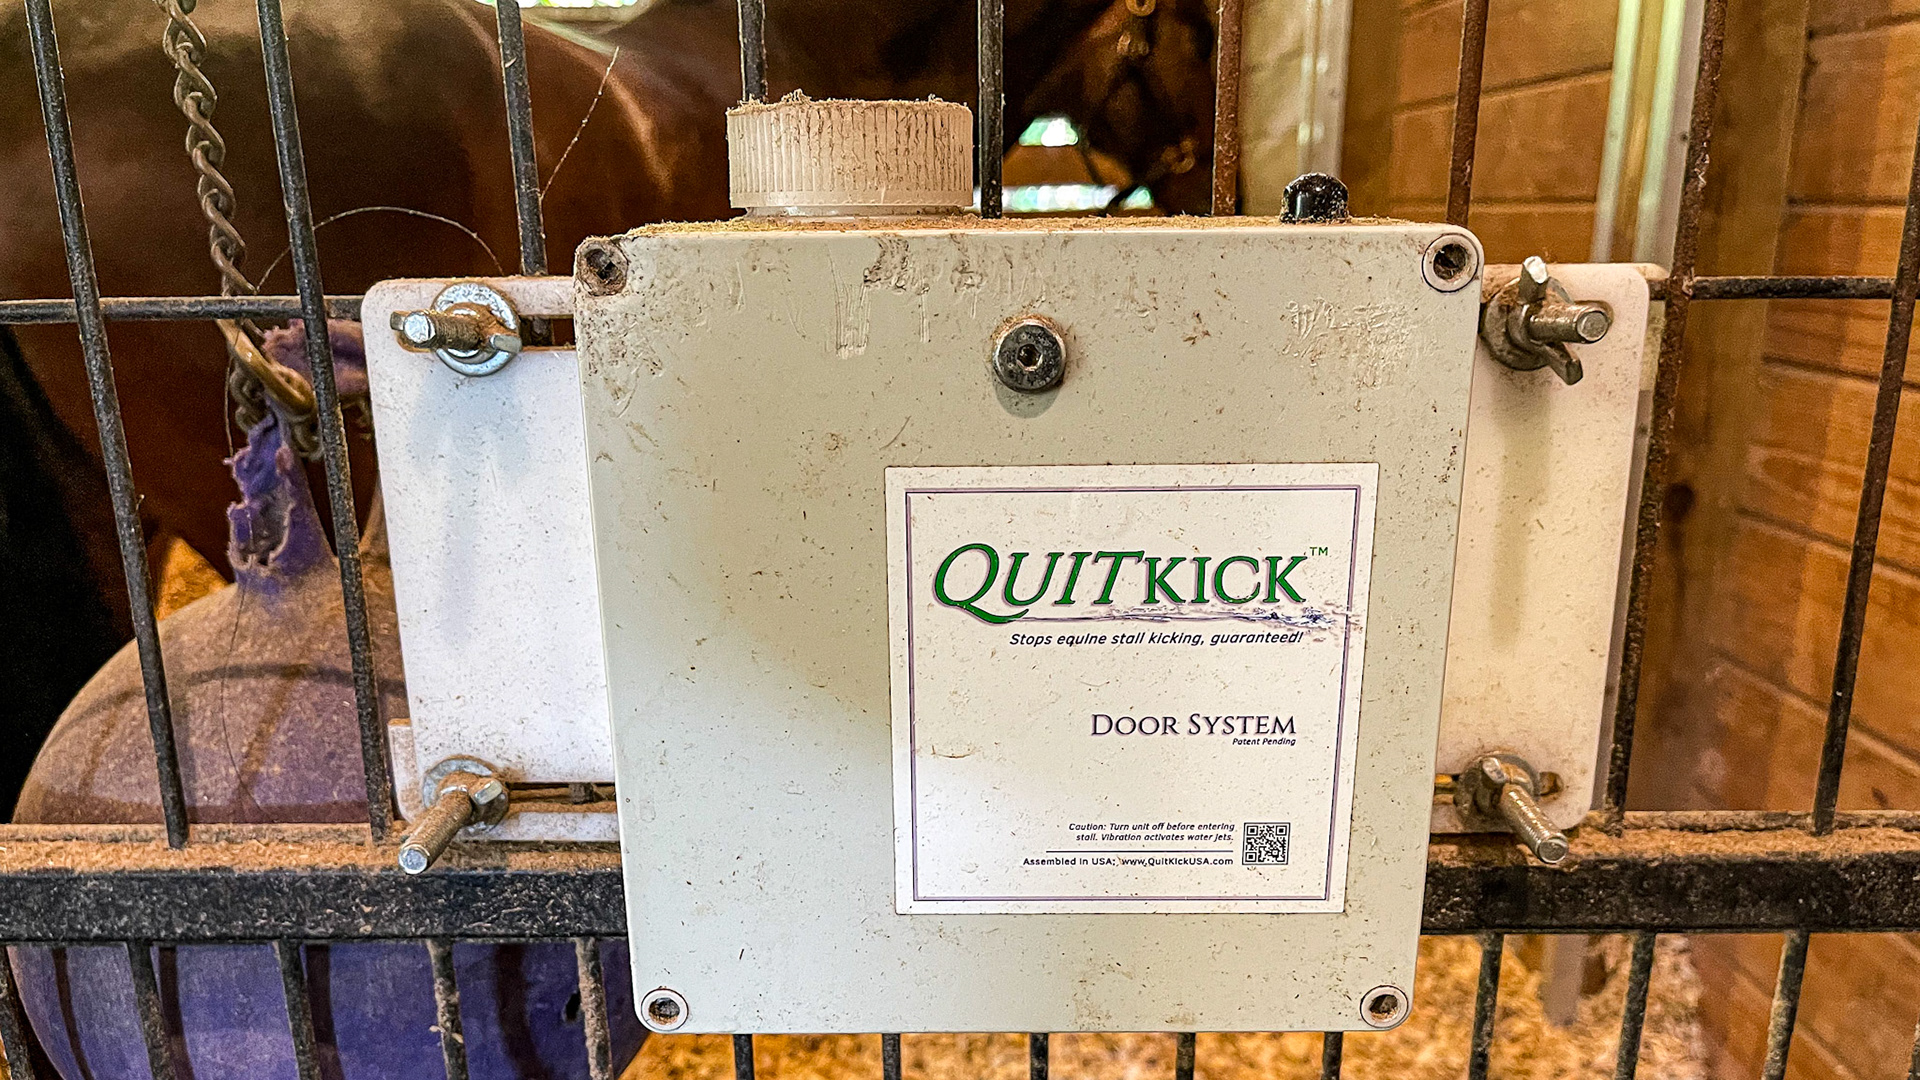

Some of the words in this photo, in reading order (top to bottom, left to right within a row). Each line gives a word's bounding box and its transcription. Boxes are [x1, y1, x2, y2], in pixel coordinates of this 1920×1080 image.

[1010, 633, 1053, 647] Stops
[1057, 632, 1107, 647] equine
[1111, 632, 1146, 645] stall
[1148, 632, 1204, 646] kicking,
[1210, 631, 1304, 646] guaranteed!
[1091, 713, 1179, 736] DOOR
[1188, 713, 1297, 736] SYSTEM
[1232, 737, 1260, 746] Patent
[1262, 737, 1296, 746] Pending
[1069, 823, 1107, 831] Caution:
[1110, 823, 1130, 831] Turn
[1132, 823, 1150, 831] unit
[1152, 822, 1165, 831] off
[1166, 822, 1195, 831] before
[1197, 822, 1235, 832] entering
[1076, 833, 1098, 841] stall.
[1101, 833, 1141, 841] Vibration
[1144, 833, 1185, 841] activates
[1187, 833, 1212, 841] water
[1214, 833, 1234, 843] jets.
[1023, 857, 1077, 866] Assembled
[1079, 857, 1088, 866] in
